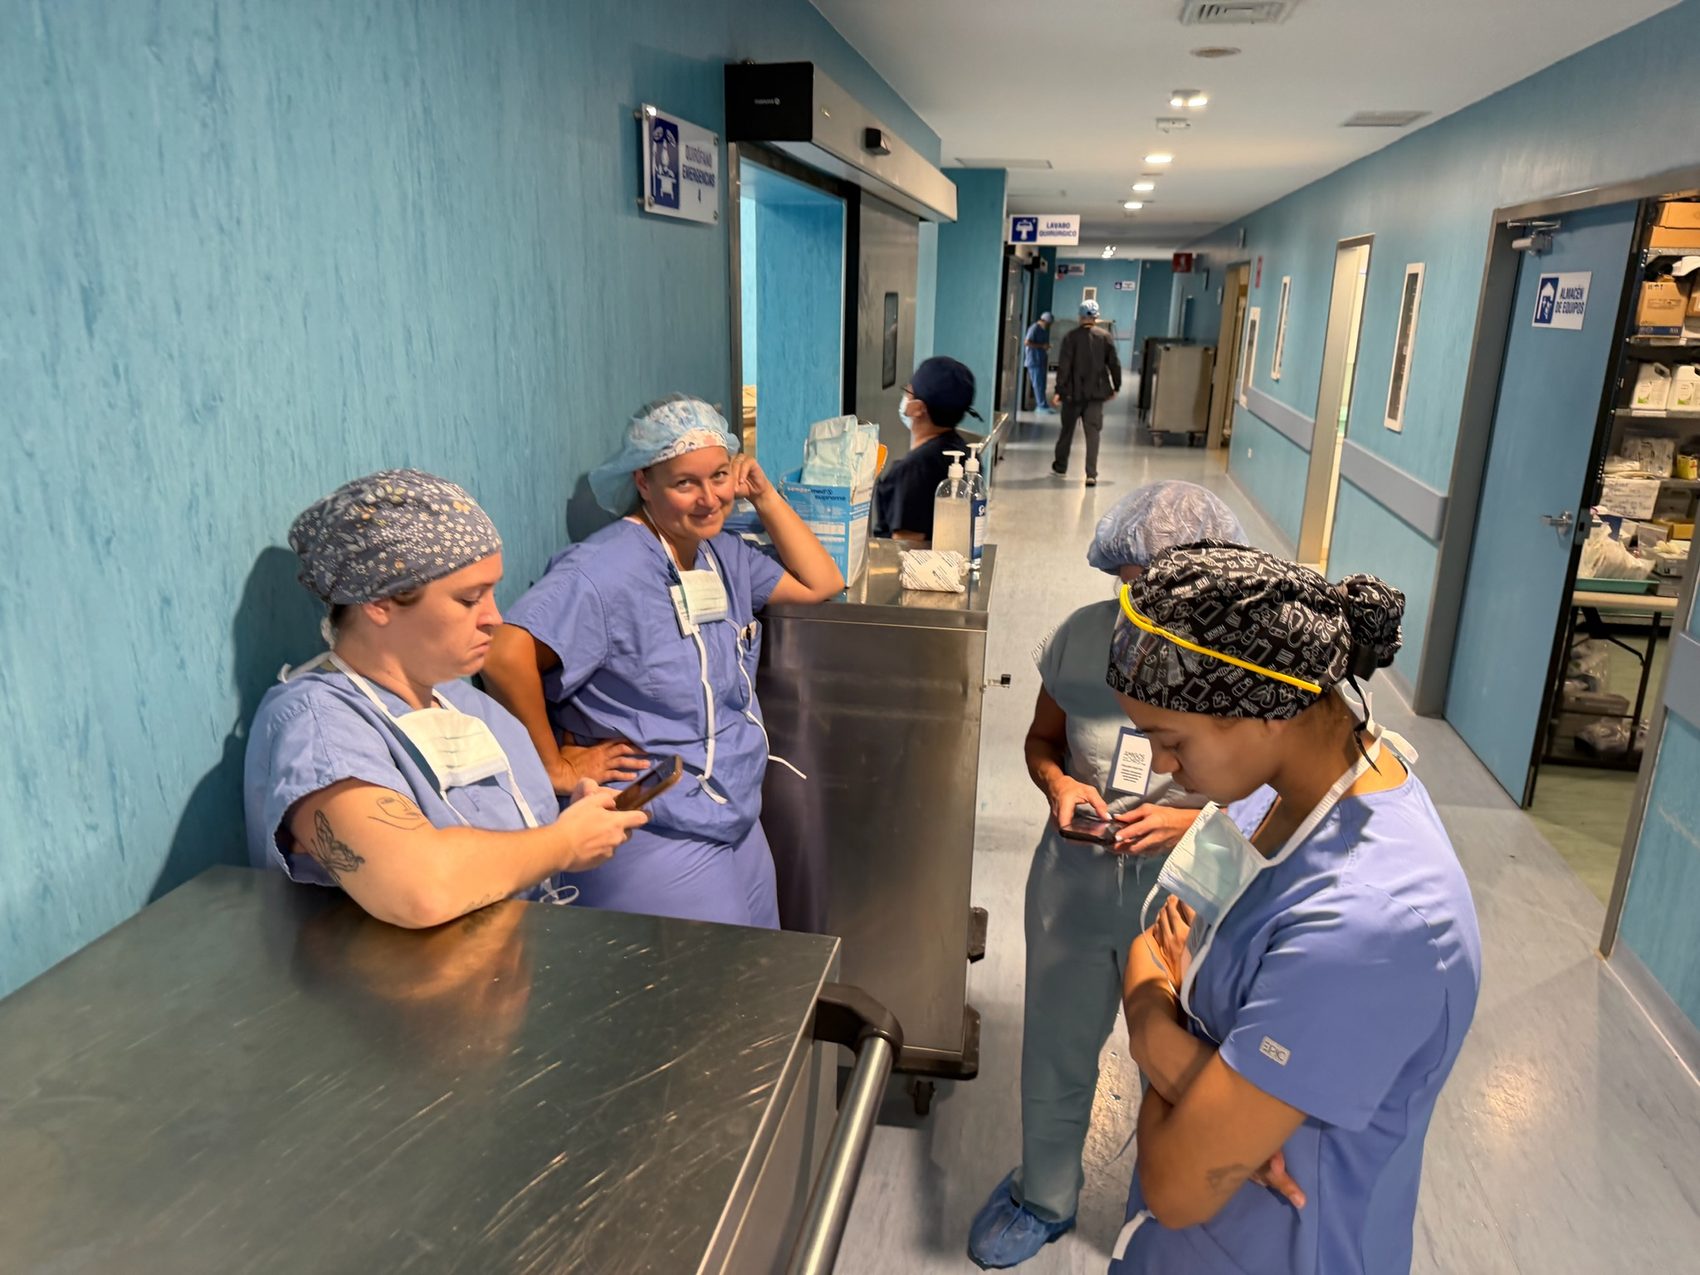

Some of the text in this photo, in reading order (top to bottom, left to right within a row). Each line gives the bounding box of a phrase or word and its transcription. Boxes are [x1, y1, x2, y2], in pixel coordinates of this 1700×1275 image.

[682, 163, 715, 188] EMERGENCIAS
[1555, 301, 1584, 315] DE EQUIPOS
